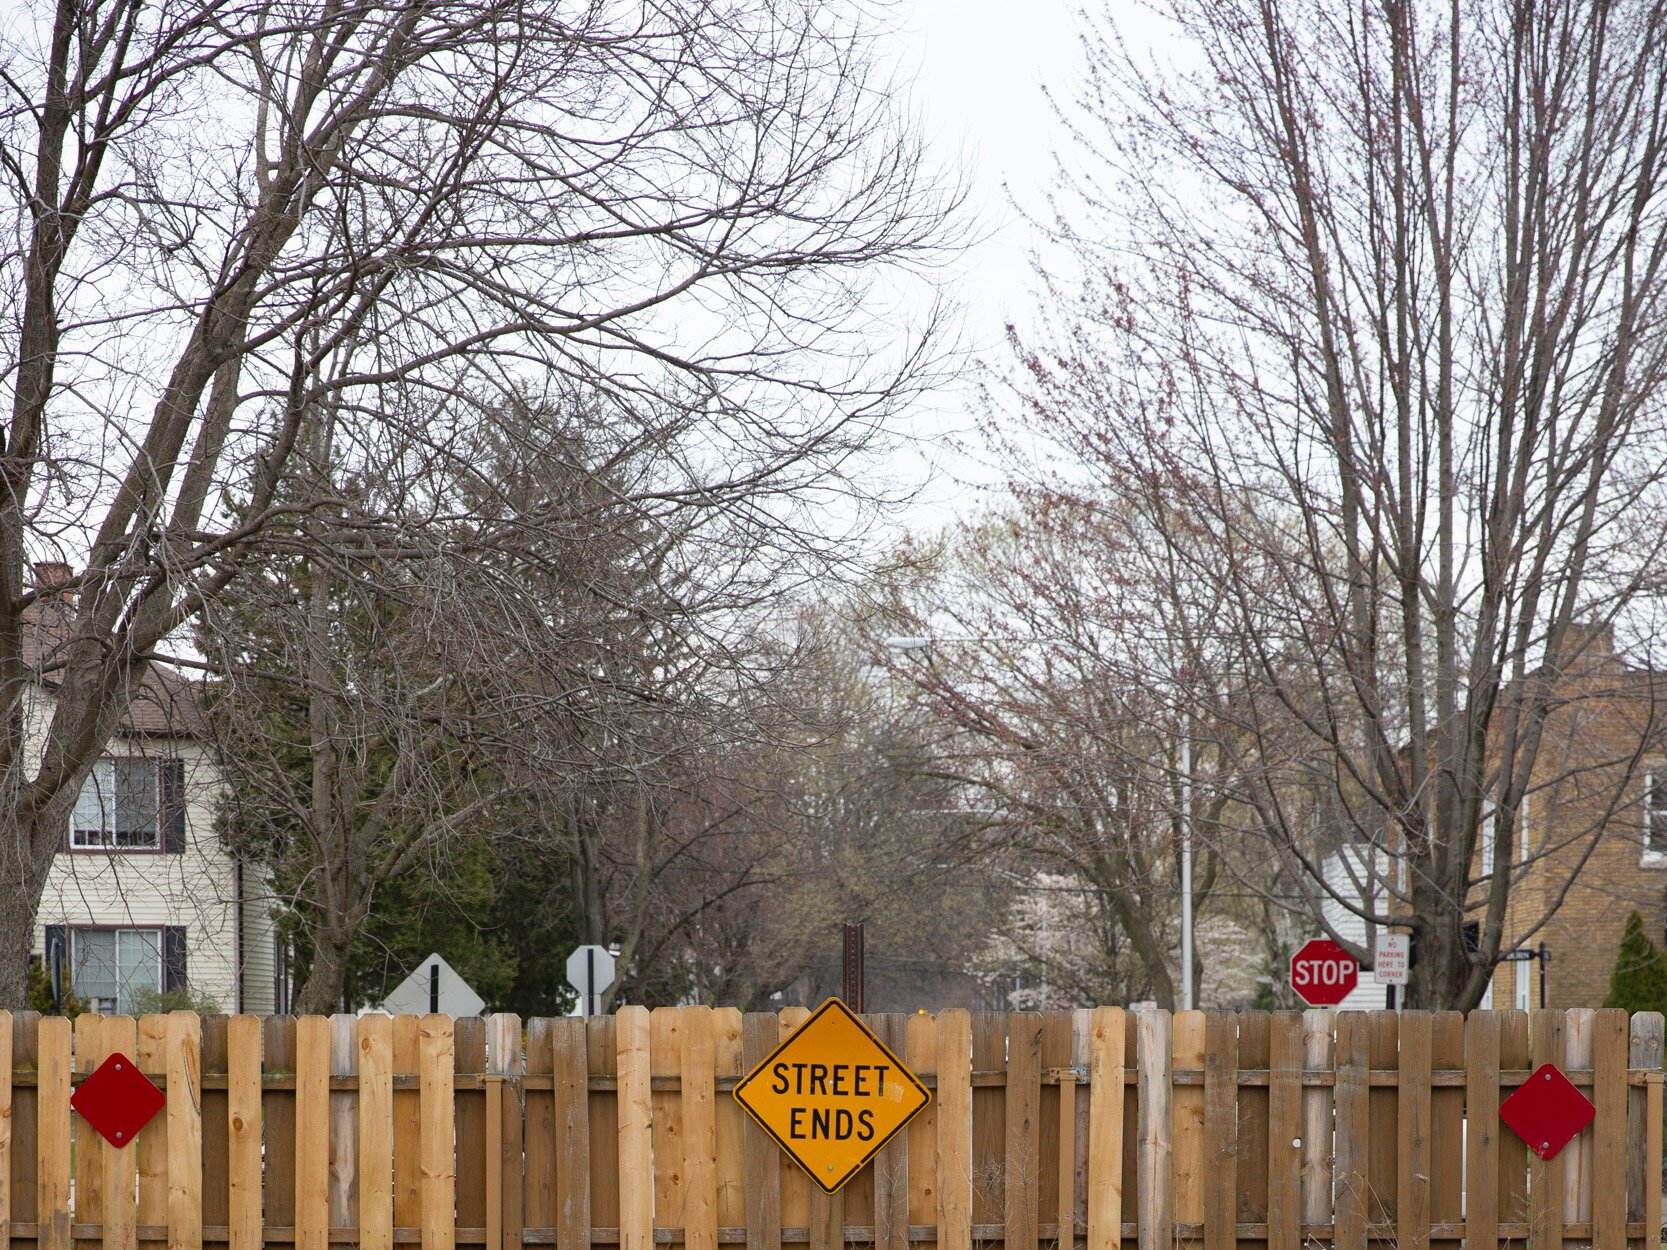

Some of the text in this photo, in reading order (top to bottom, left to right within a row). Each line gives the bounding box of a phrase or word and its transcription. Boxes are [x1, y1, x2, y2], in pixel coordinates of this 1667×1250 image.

[1295, 960, 1354, 985] STOP
[772, 1063, 890, 1097] STREET
[790, 1108, 875, 1141] ENDS
